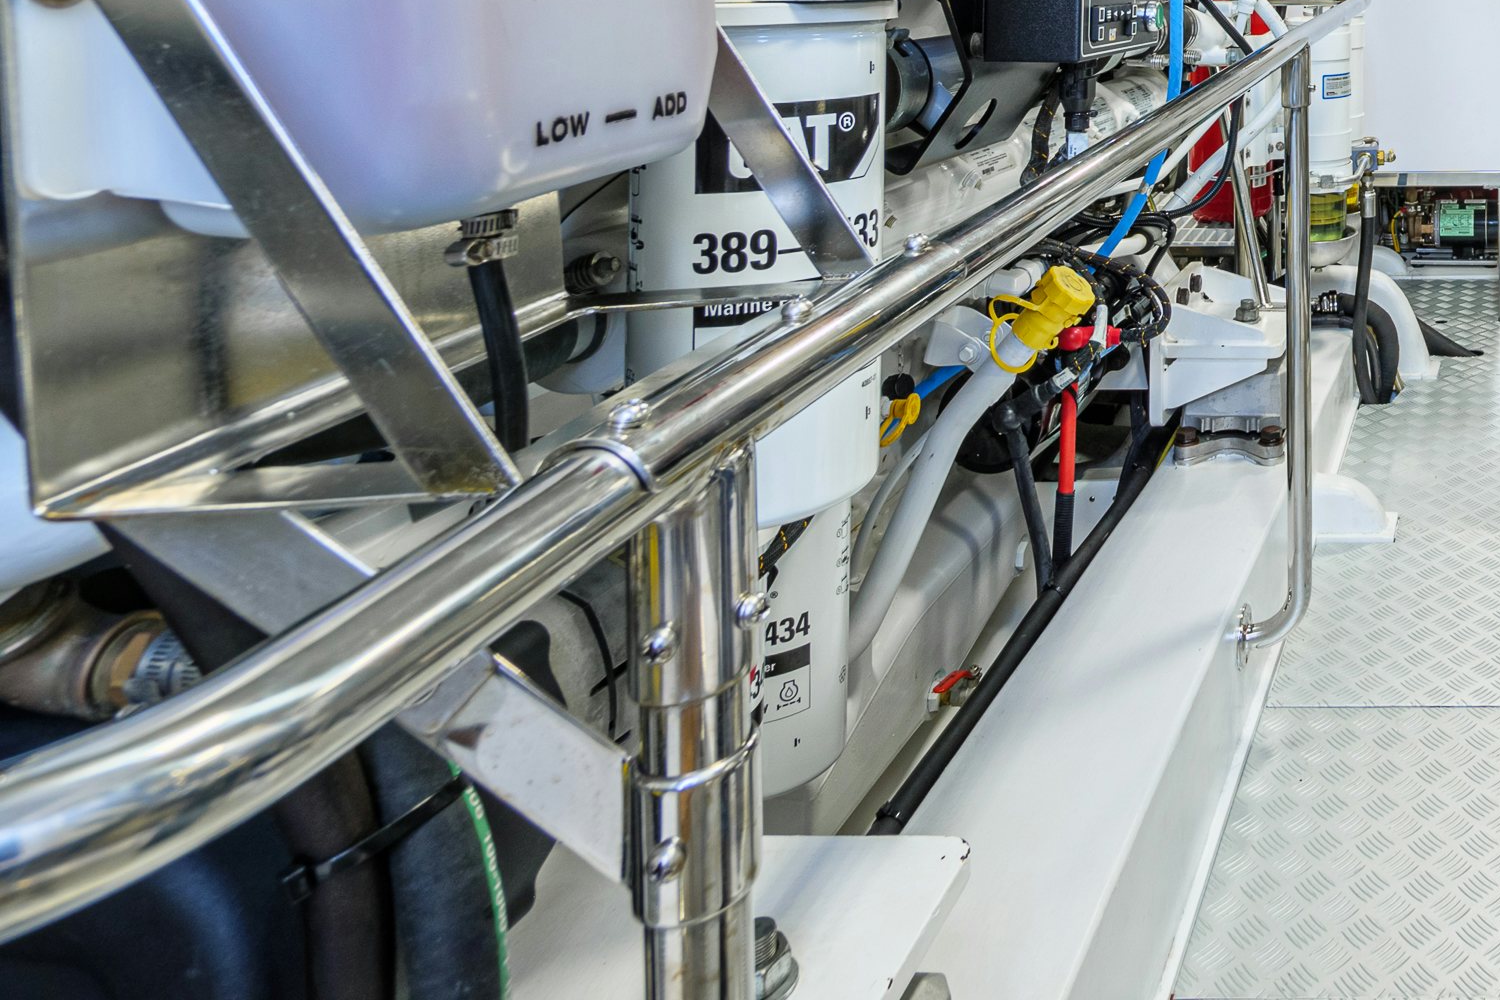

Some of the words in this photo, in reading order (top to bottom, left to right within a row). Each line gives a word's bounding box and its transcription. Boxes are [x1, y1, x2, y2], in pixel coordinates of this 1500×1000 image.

[536, 111, 590, 147] LOW
[652, 91, 688, 121] ADD
[704, 299, 773, 317] Marine
